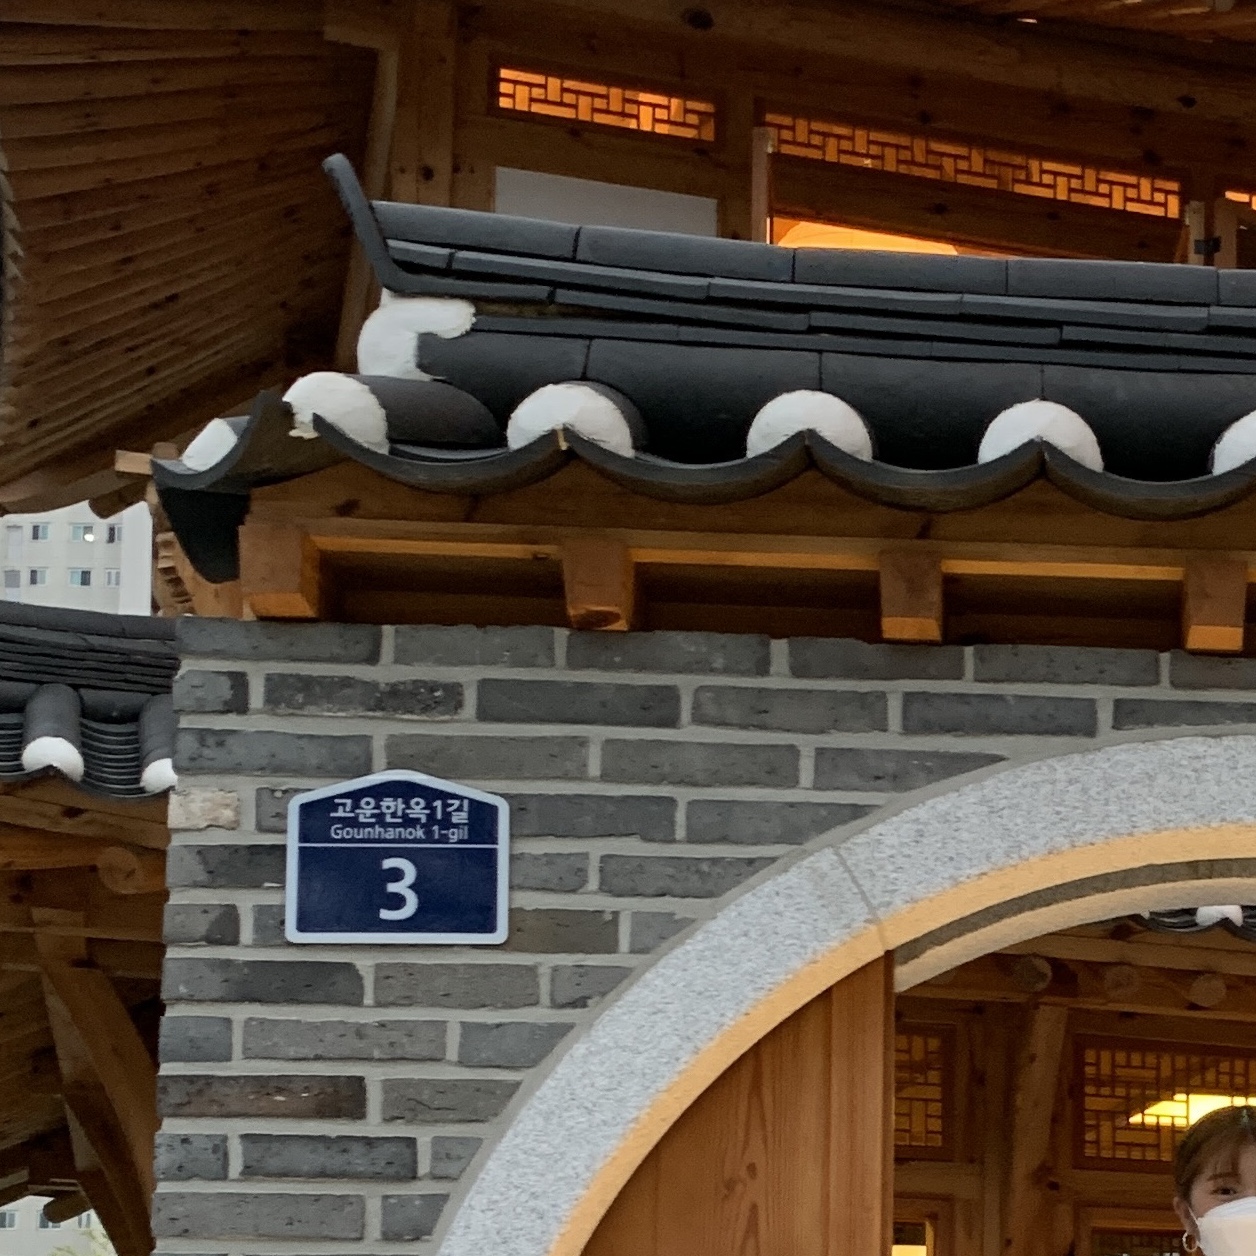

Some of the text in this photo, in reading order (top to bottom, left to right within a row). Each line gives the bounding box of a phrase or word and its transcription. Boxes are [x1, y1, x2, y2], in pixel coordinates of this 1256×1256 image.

[329, 797, 469, 824] 고운한옥1길
[330, 824, 469, 842] Gounhanok 1-gil
[379, 857, 419, 921] 3
